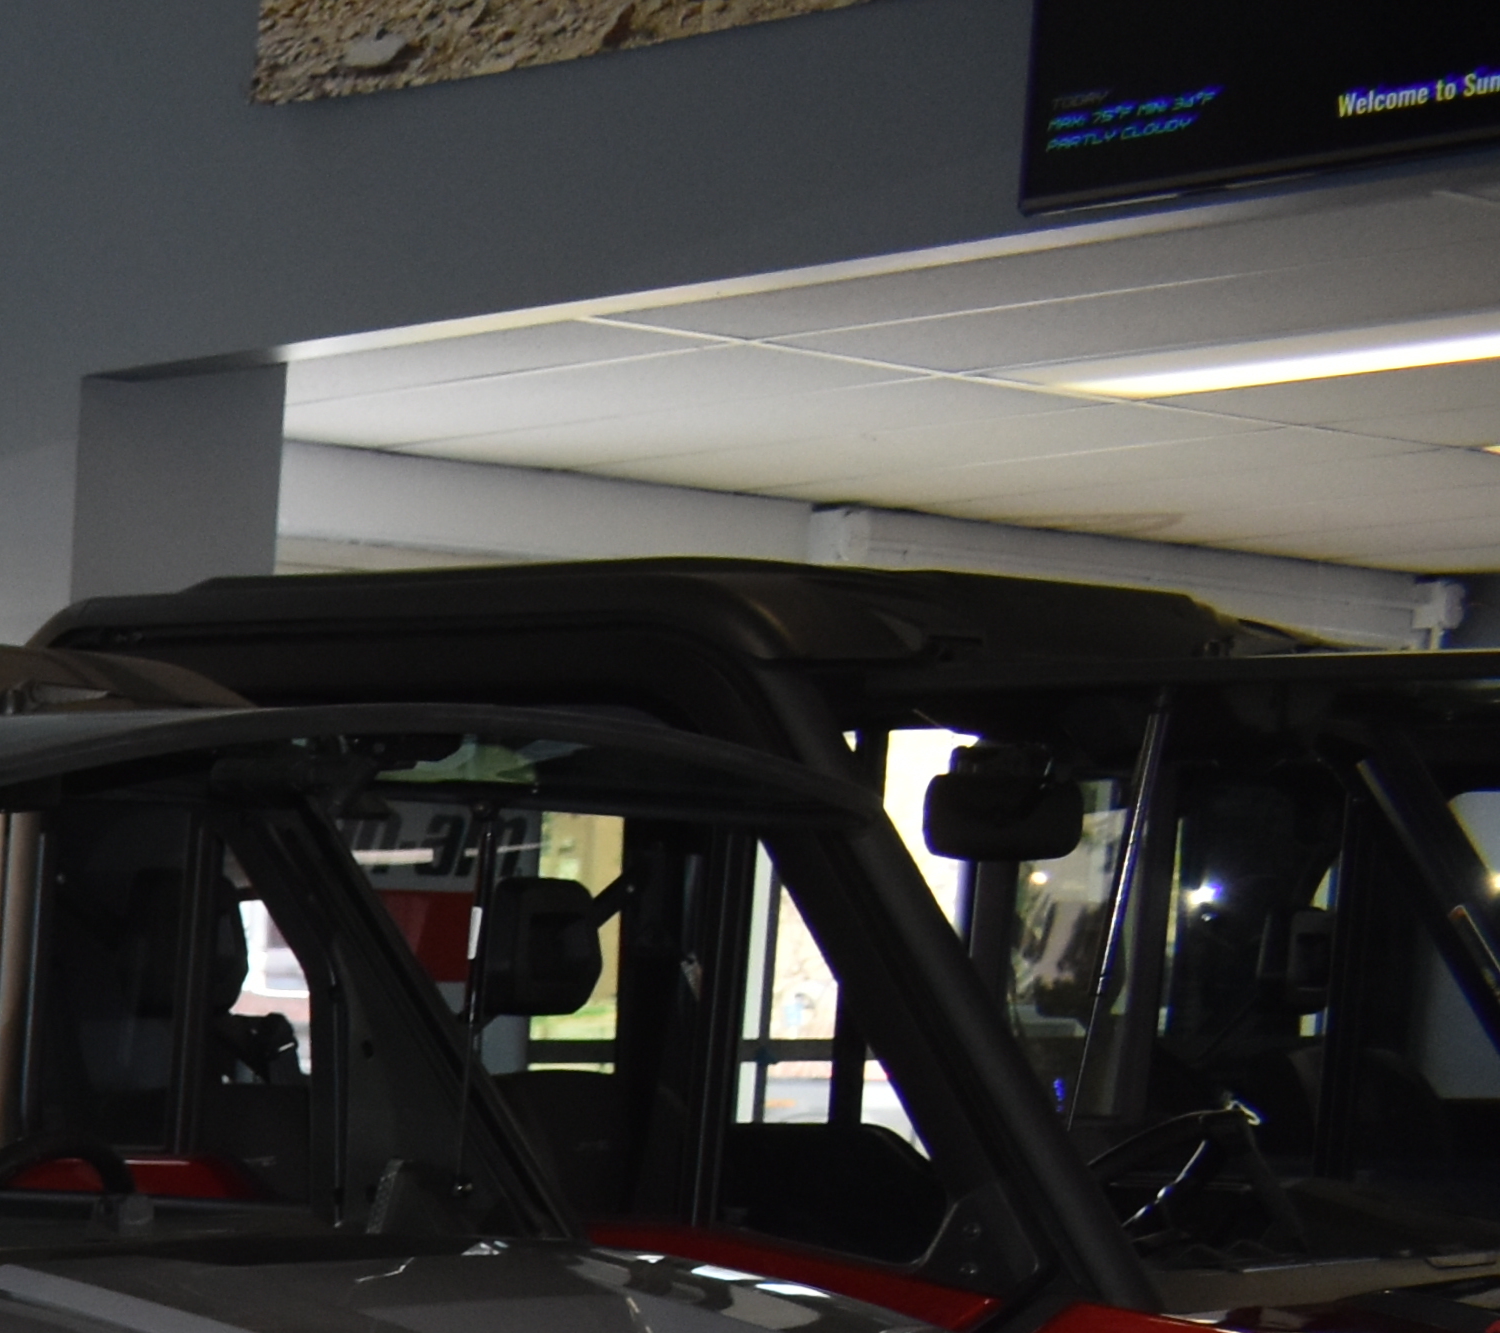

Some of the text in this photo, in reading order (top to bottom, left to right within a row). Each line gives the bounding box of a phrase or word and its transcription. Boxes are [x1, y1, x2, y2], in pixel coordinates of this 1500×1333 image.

[1338, 85, 1428, 117] Welcome
[1435, 80, 1456, 102] to
[1046, 117, 1194, 152] PARTLY CLOUDY
